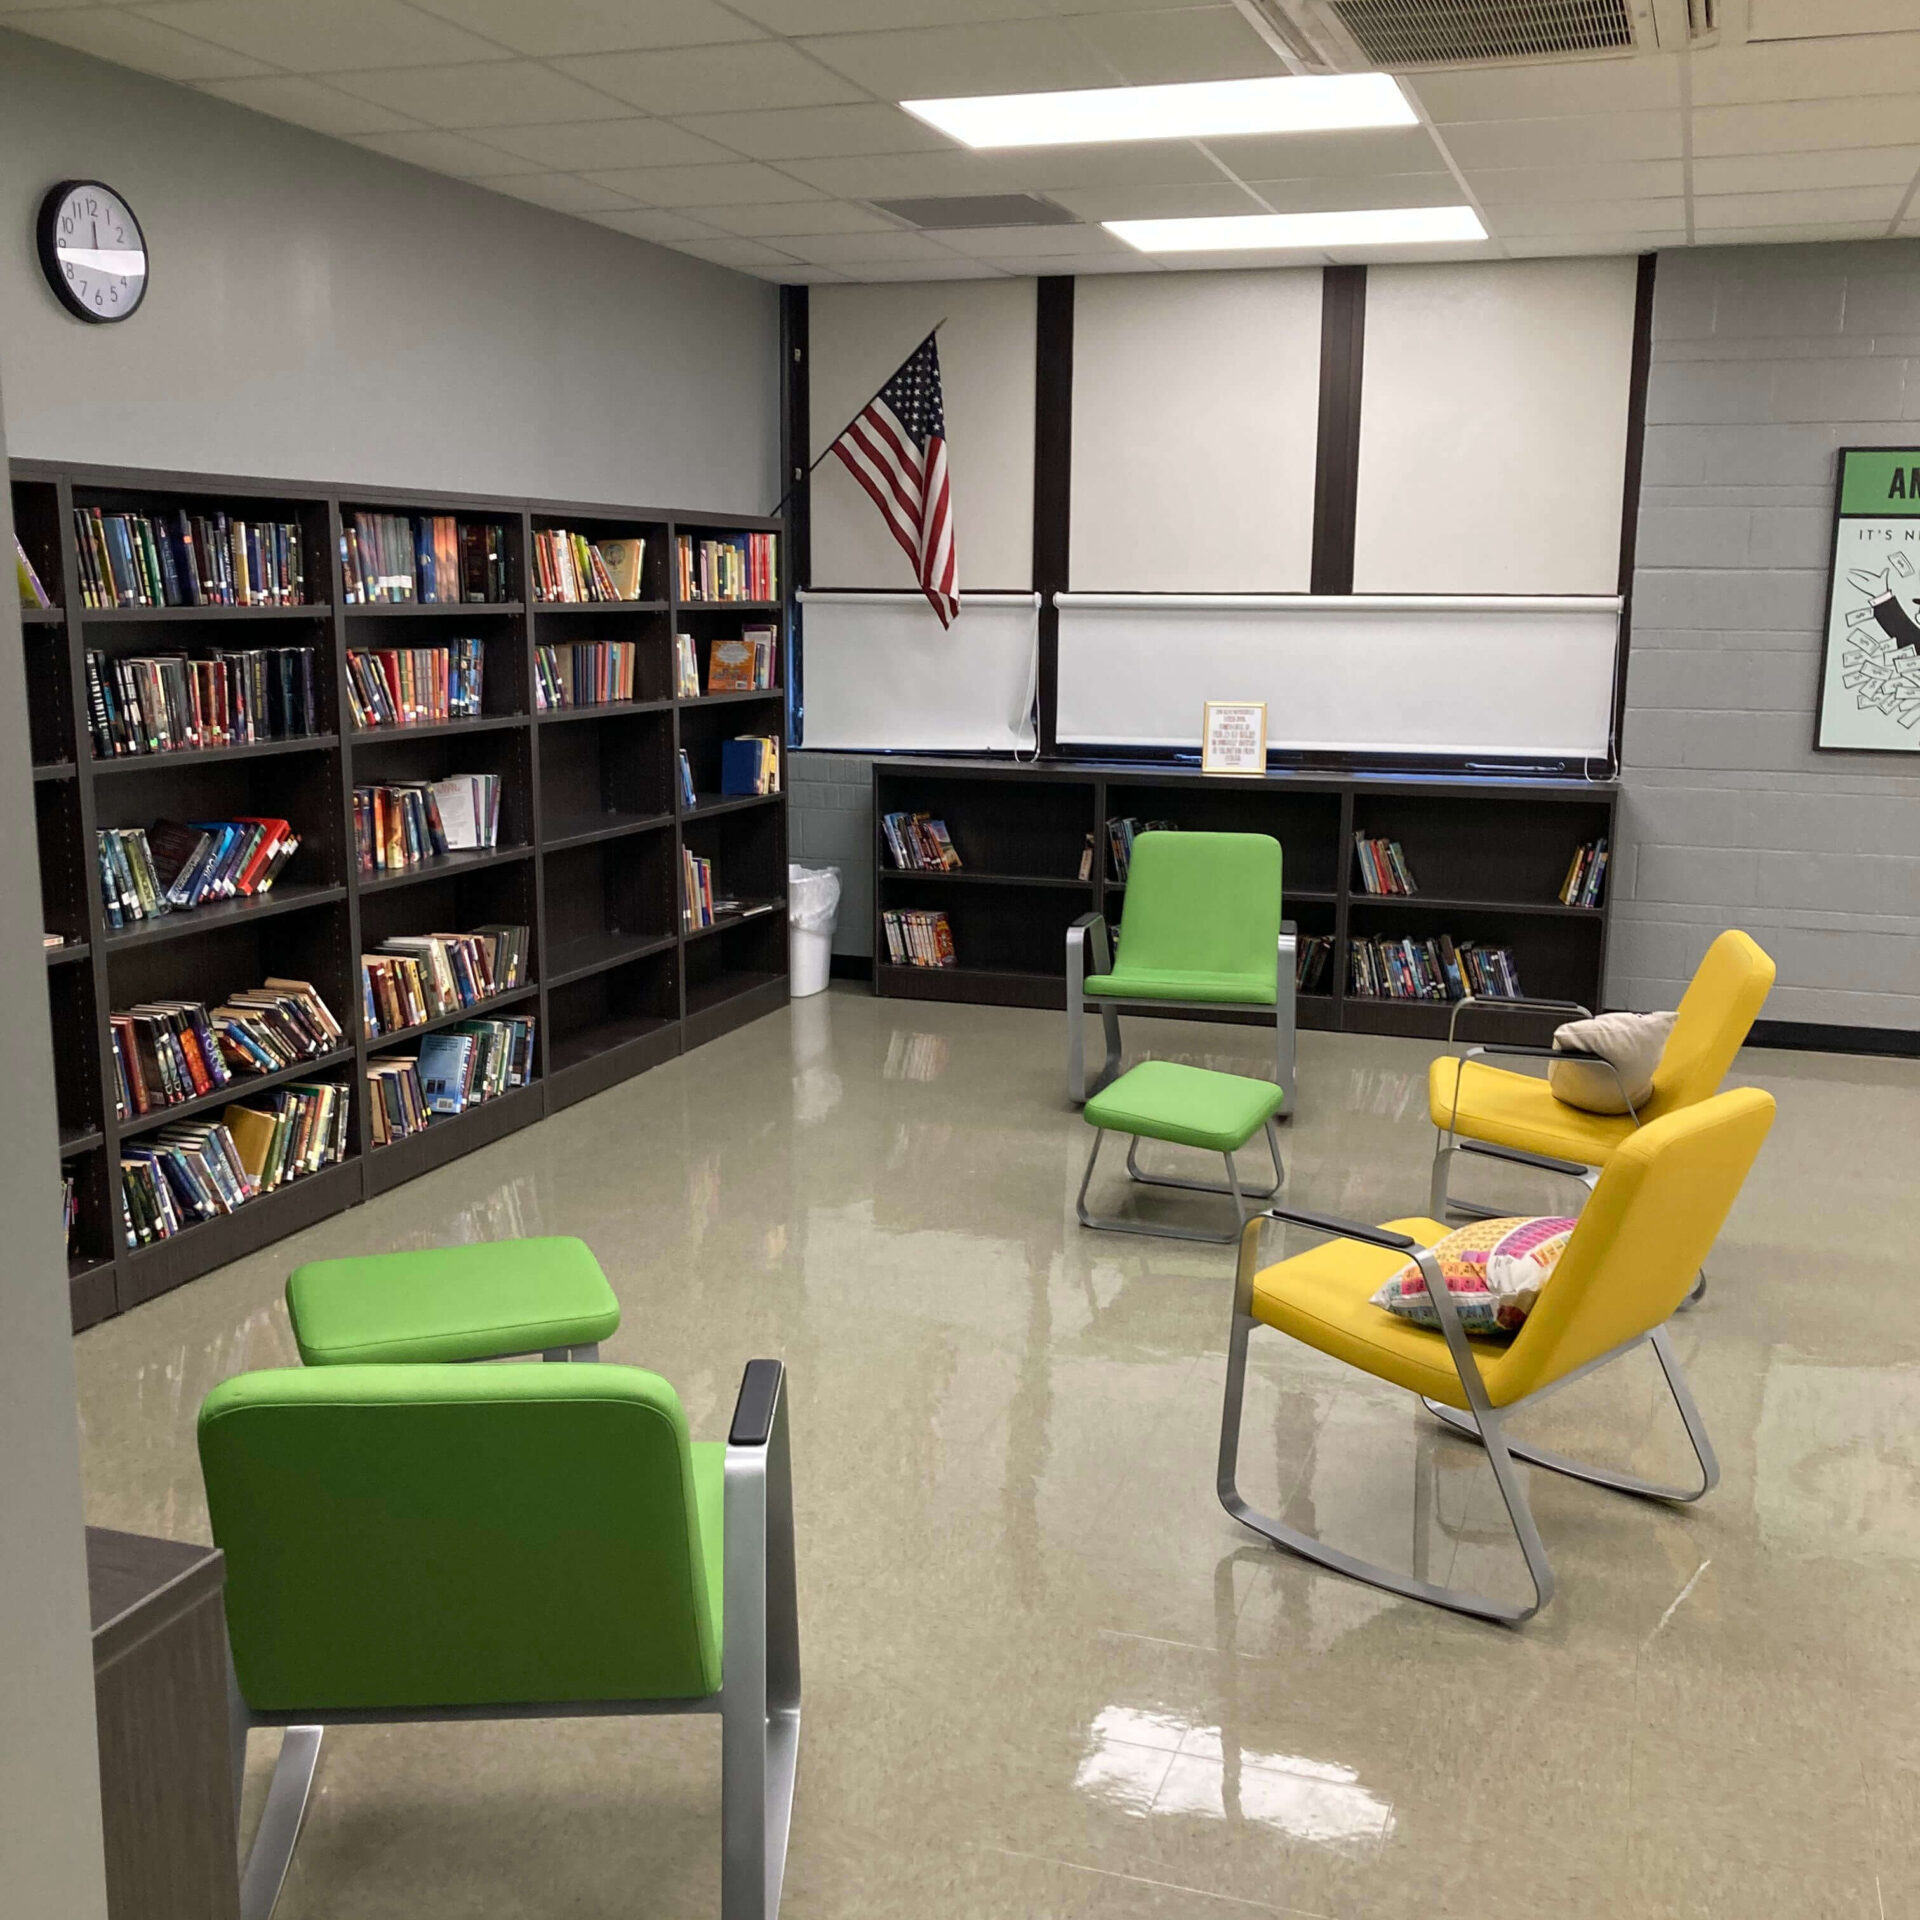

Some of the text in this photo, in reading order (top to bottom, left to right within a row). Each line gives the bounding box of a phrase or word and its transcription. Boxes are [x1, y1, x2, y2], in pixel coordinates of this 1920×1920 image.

[72, 201, 82, 220] 11
[85, 198, 99, 218] 12
[61, 216, 74, 234] 10
[105, 208, 111, 226] 1
[115, 226, 125, 243] 2
[66, 262, 75, 280] 8
[79, 280, 88, 297] 7
[120, 276, 128, 289] 4
[95, 290, 103, 306] 6
[110, 285, 118, 302] 5
[1859, 529, 1893, 541] IT'S
